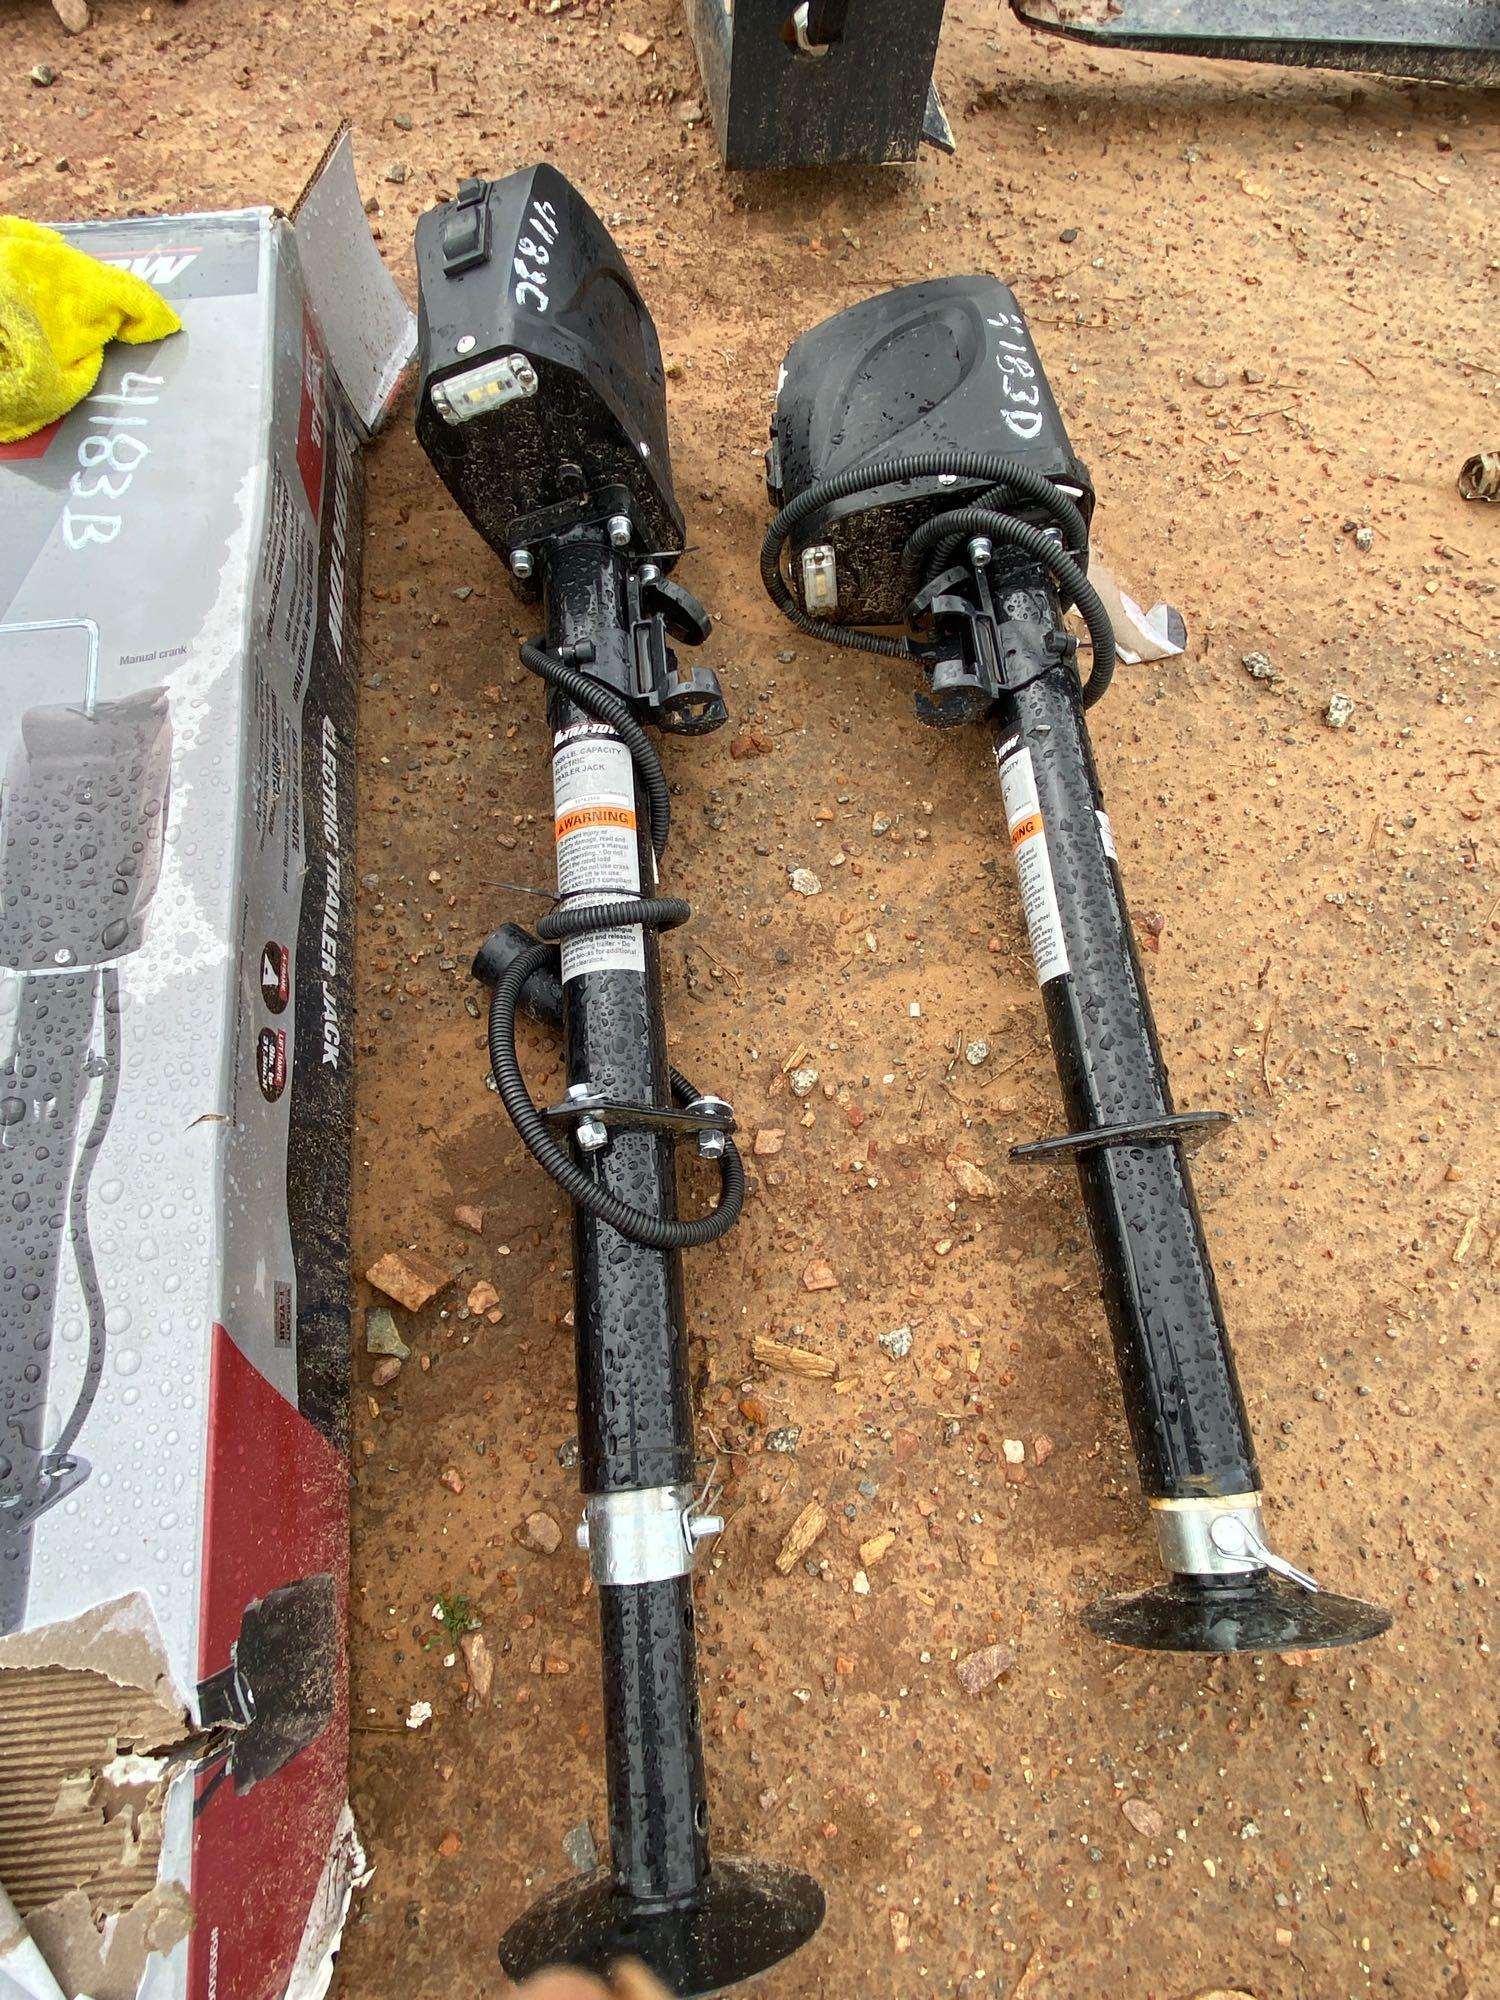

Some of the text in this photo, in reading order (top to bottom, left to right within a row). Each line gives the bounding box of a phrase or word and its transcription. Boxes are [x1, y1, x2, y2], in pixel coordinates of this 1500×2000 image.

[68, 372, 165, 549] 4183B
[267, 540, 287, 643] CONSTRUCTION
[119, 645, 187, 666] Manual crank
[292, 630, 309, 704] OPERATION
[579, 746, 622, 755] CAPACITY
[582, 764, 605, 773] JACK
[268, 743, 281, 838] PROTTION
[291, 788, 300, 854] OPERATE
[564, 811, 628, 829] WARNING
[321, 715, 340, 1070] ELECTRIC TRAILER JACK
[608, 934, 636, 942] releasing
[276, 1033, 285, 1083] LIFT RANGE
